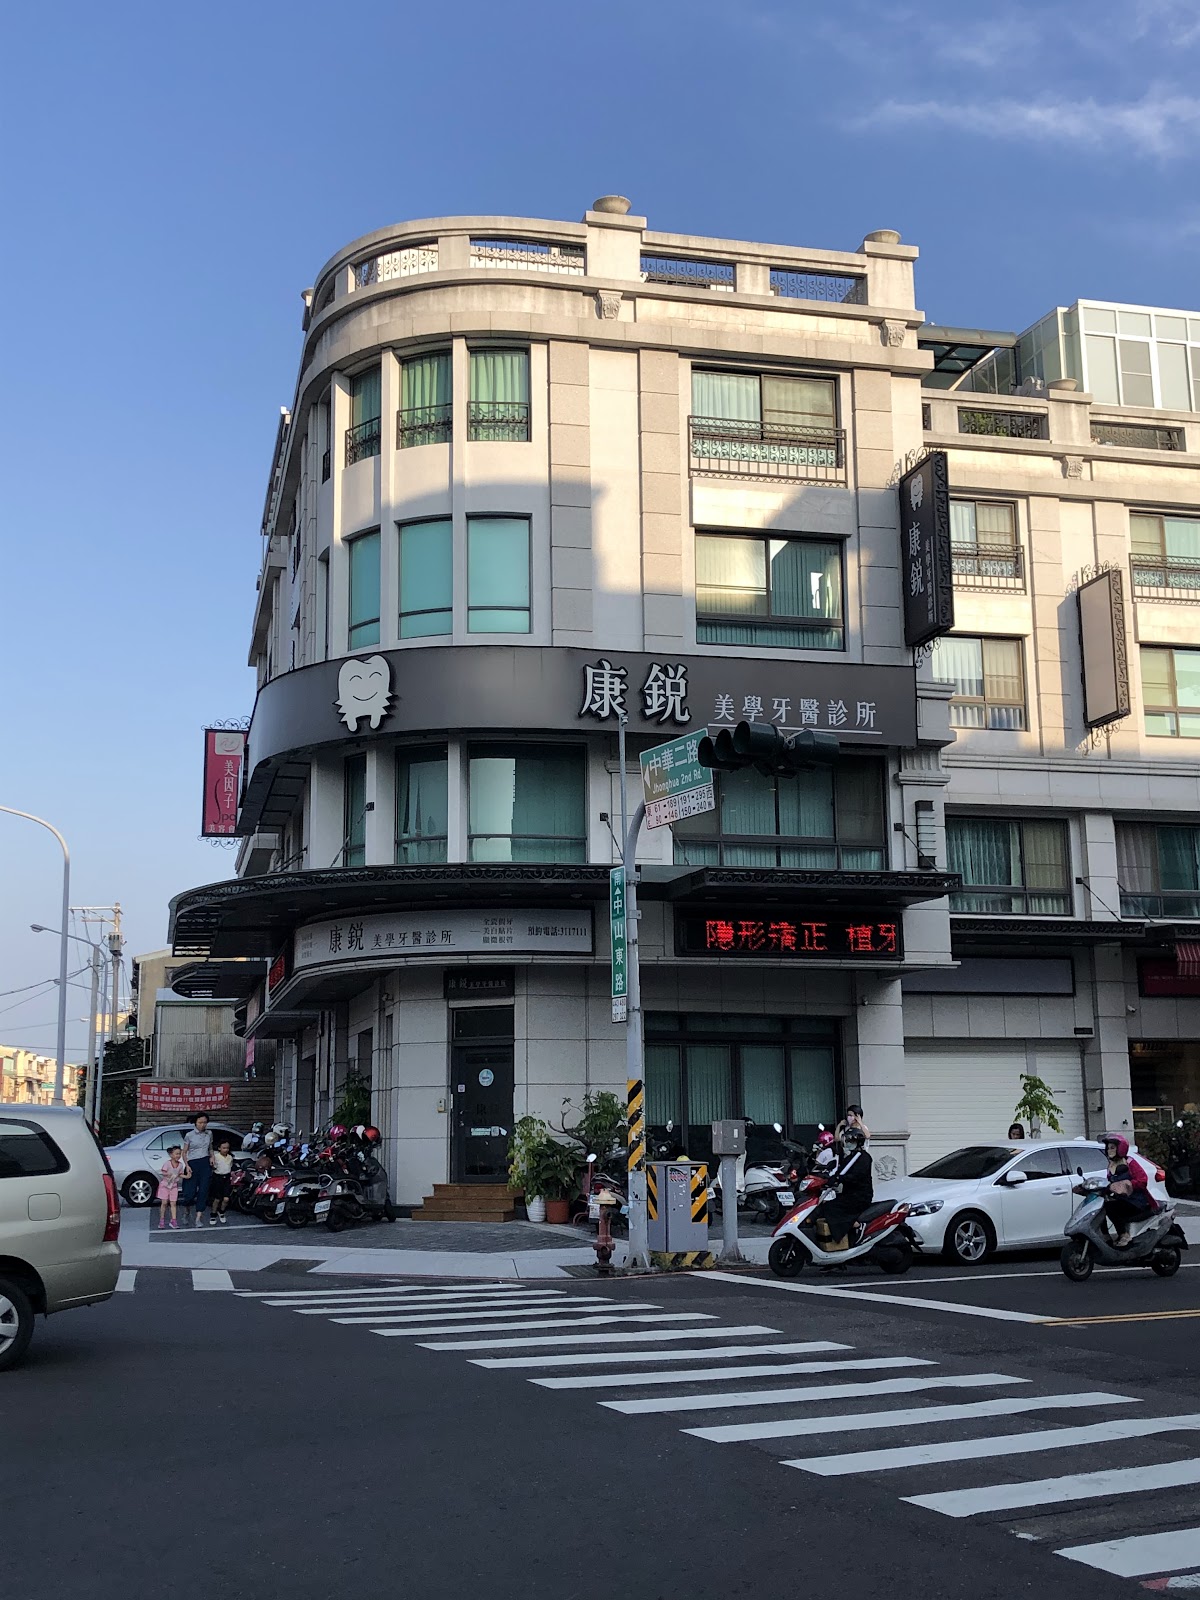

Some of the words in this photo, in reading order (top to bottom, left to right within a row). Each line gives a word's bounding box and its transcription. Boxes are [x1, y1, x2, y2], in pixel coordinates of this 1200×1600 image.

[713, 693, 877, 728] 美學牙醫診所
[649, 738, 699, 777] 中華二路
[223, 759, 238, 809] 美因子
[652, 777, 680, 795] Jhonghua
[680, 772, 692, 785] 2nd
[613, 871, 622, 887] 南
[373, 929, 453, 948] 美學牙醫診所
[613, 895, 624, 992] 中山東路
[845, 923, 897, 953] 植牙
